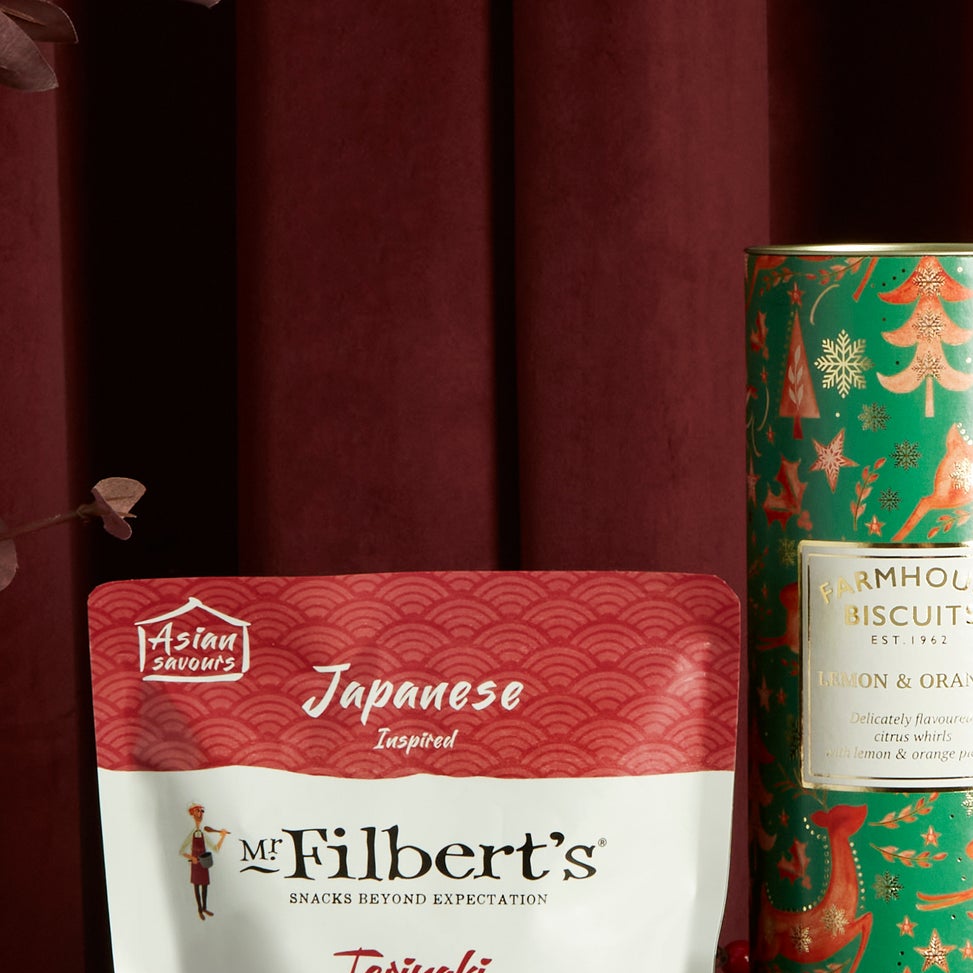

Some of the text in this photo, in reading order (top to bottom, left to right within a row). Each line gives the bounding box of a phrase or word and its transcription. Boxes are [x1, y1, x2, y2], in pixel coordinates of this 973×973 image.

[148, 622, 237, 655] Asian
[152, 655, 236, 672] savours
[896, 673, 911, 689] &
[302, 663, 524, 726] Japanese
[850, 712, 912, 727] Delicately
[373, 727, 458, 755] Inspired
[874, 729, 952, 743] citrus whirls
[853, 747, 891, 760] lemon
[895, 748, 906, 760] &
[911, 750, 956, 763] orange
[289, 892, 548, 906] SNACKS BEYOND EXPECTATION
